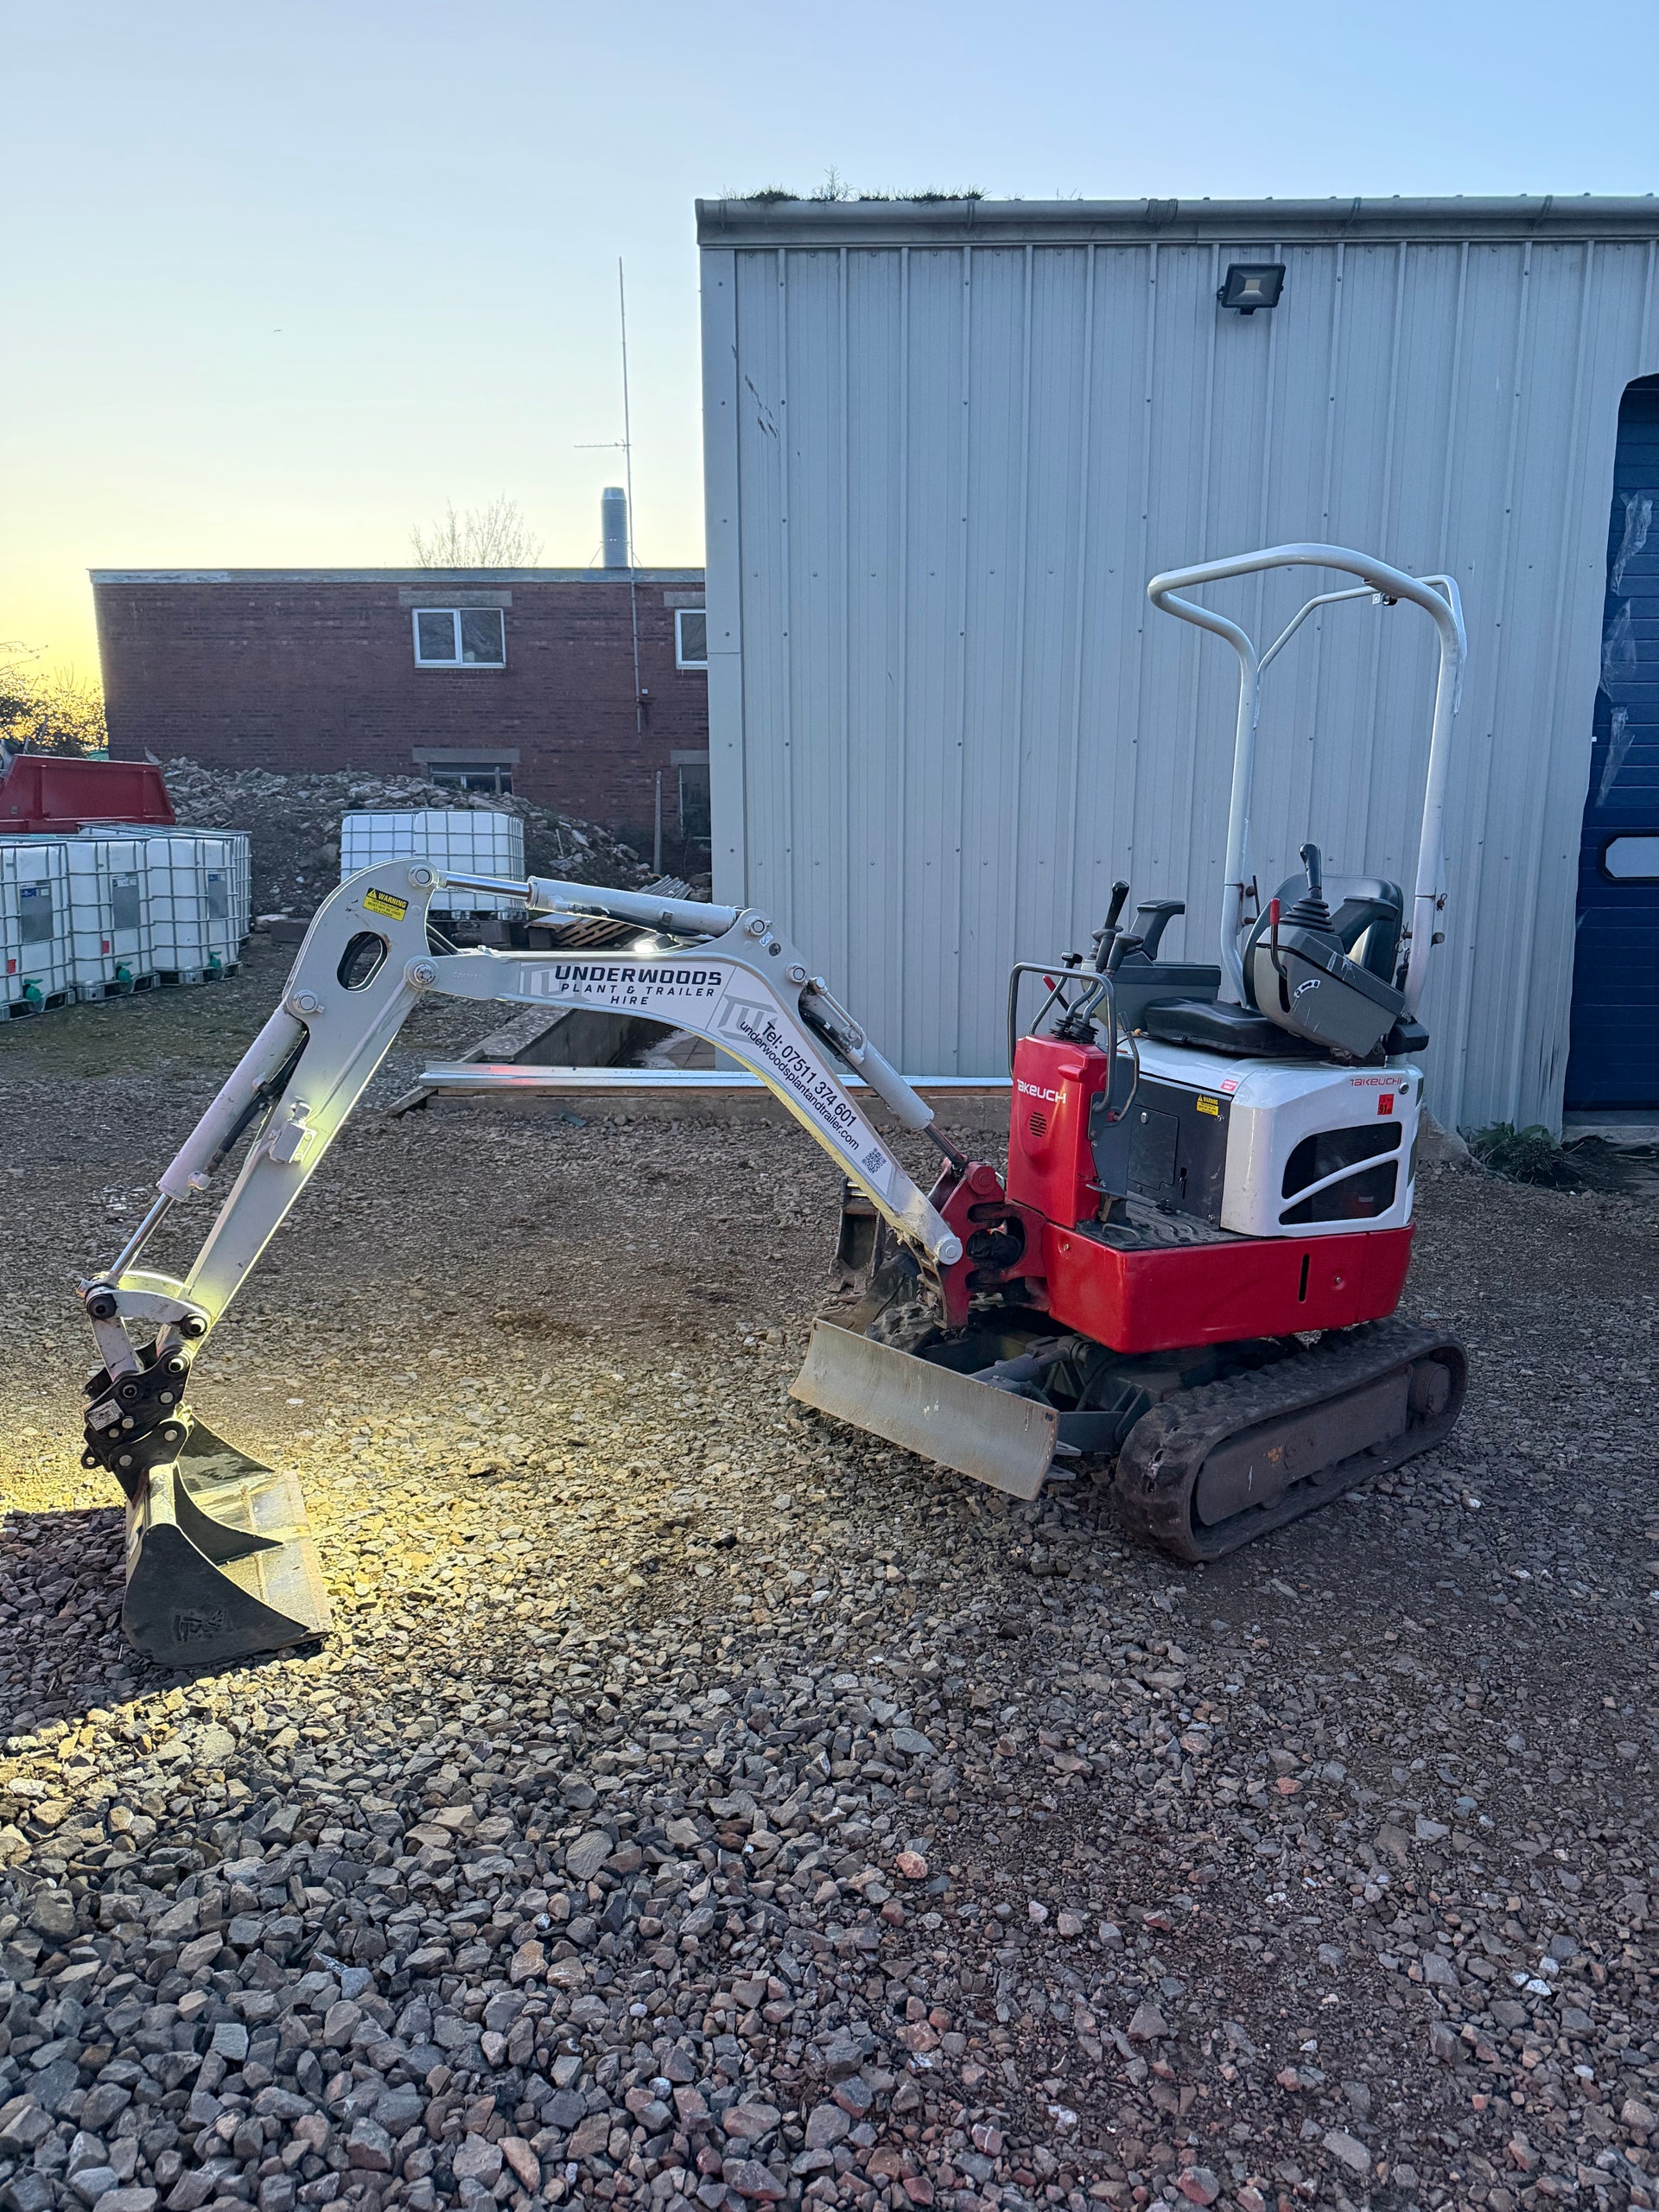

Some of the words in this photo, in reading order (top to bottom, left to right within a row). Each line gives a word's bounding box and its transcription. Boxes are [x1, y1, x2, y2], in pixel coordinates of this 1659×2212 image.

[378, 893, 407, 909] WARNING
[555, 965, 722, 986] UNDERWOODS
[561, 983, 618, 994] PLANT
[626, 985, 636, 995] &
[645, 986, 715, 997] TRAILER
[610, 995, 650, 1005] HIRE
[761, 1021, 784, 1050] Tel:
[781, 1045, 817, 1084] 07511
[814, 1081, 838, 1106] 374
[834, 1103, 857, 1128] 601
[740, 1020, 860, 1151] underwoodsplantandtrailer.com
